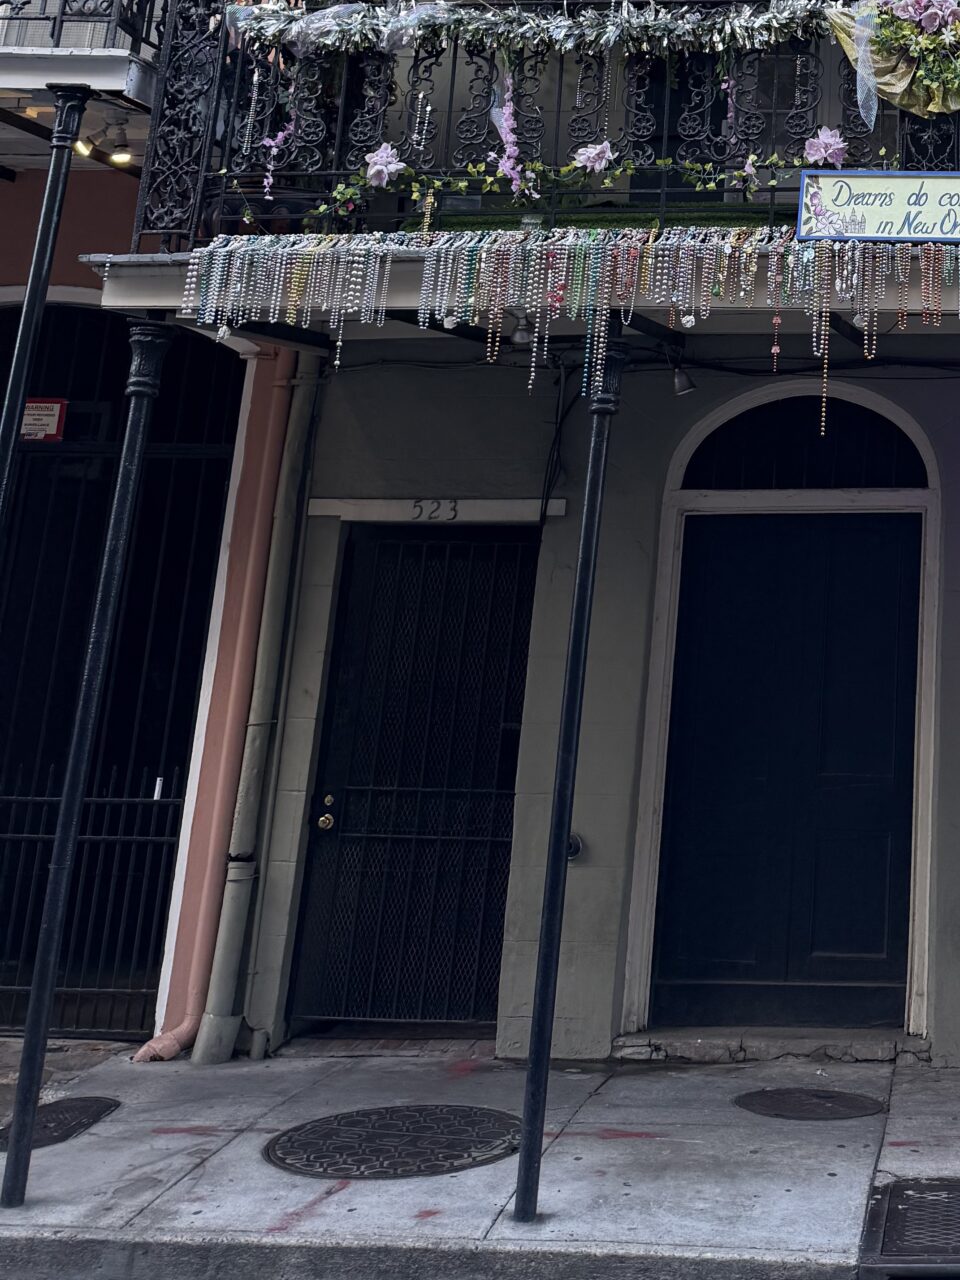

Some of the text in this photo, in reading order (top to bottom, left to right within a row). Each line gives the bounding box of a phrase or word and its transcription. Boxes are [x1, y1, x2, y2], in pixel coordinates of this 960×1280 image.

[832, 180, 895, 208] Dreams
[907, 181, 928, 206] do
[875, 219, 894, 234] in
[897, 211, 938, 235] New
[411, 498, 458, 521] 523
